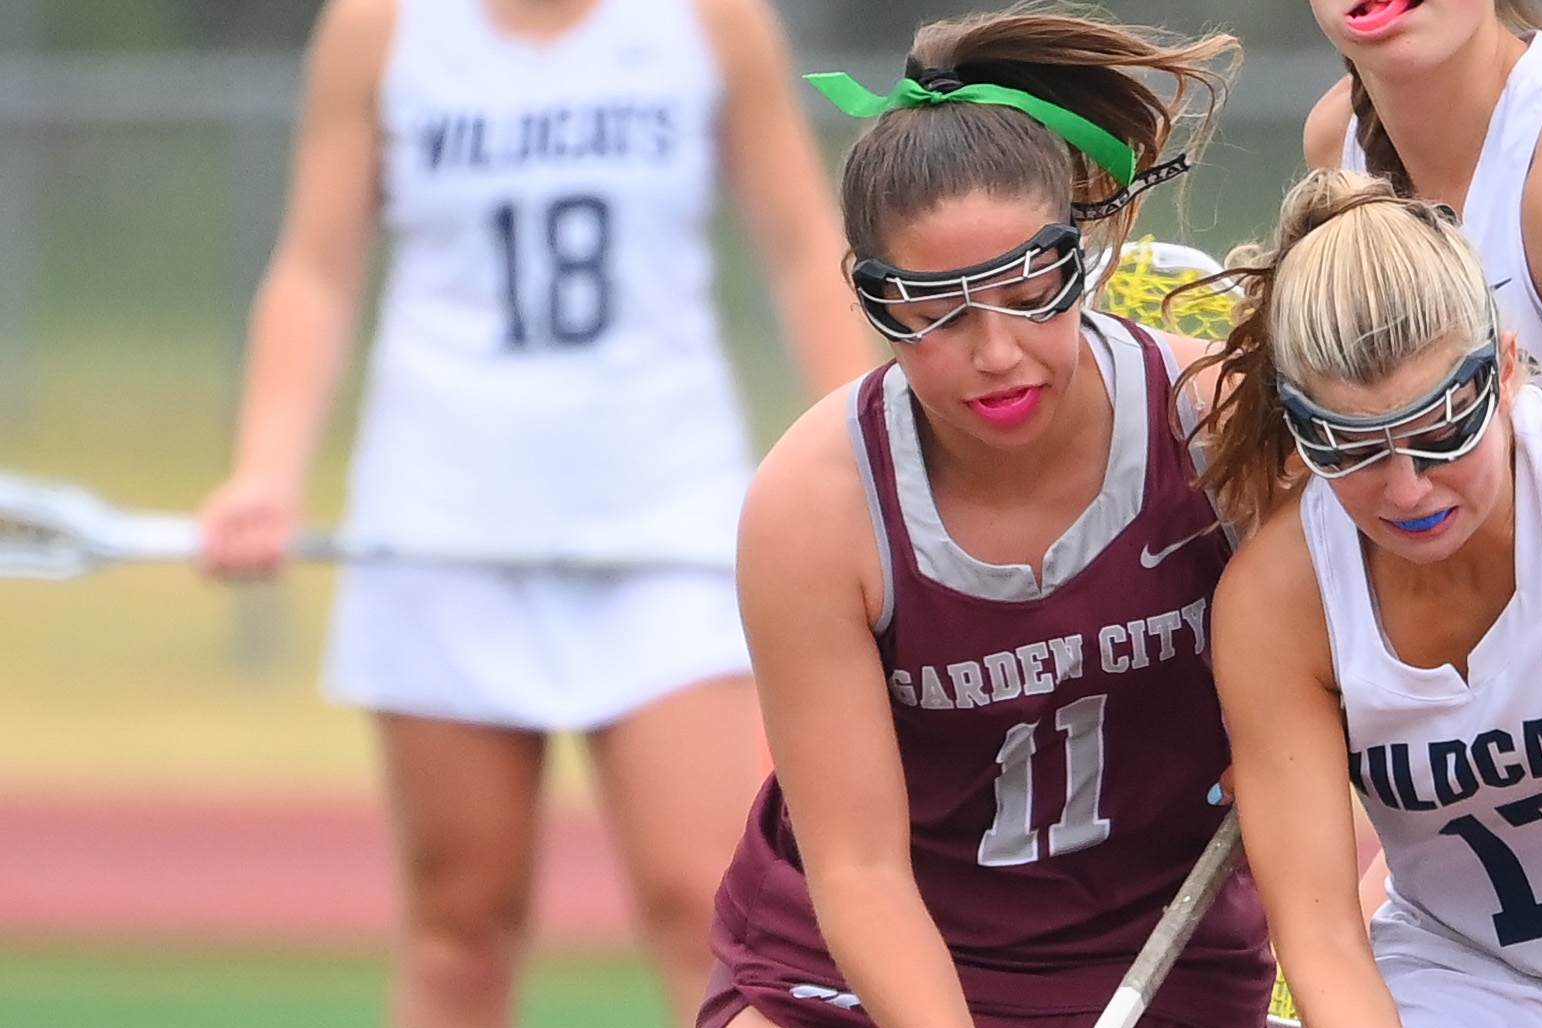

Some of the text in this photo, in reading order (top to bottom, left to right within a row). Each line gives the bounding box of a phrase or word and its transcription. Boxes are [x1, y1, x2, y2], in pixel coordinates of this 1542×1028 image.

[488, 194, 616, 351] 18
[889, 597, 1207, 709] GARDEN CITY
[977, 694, 1111, 867] 11
